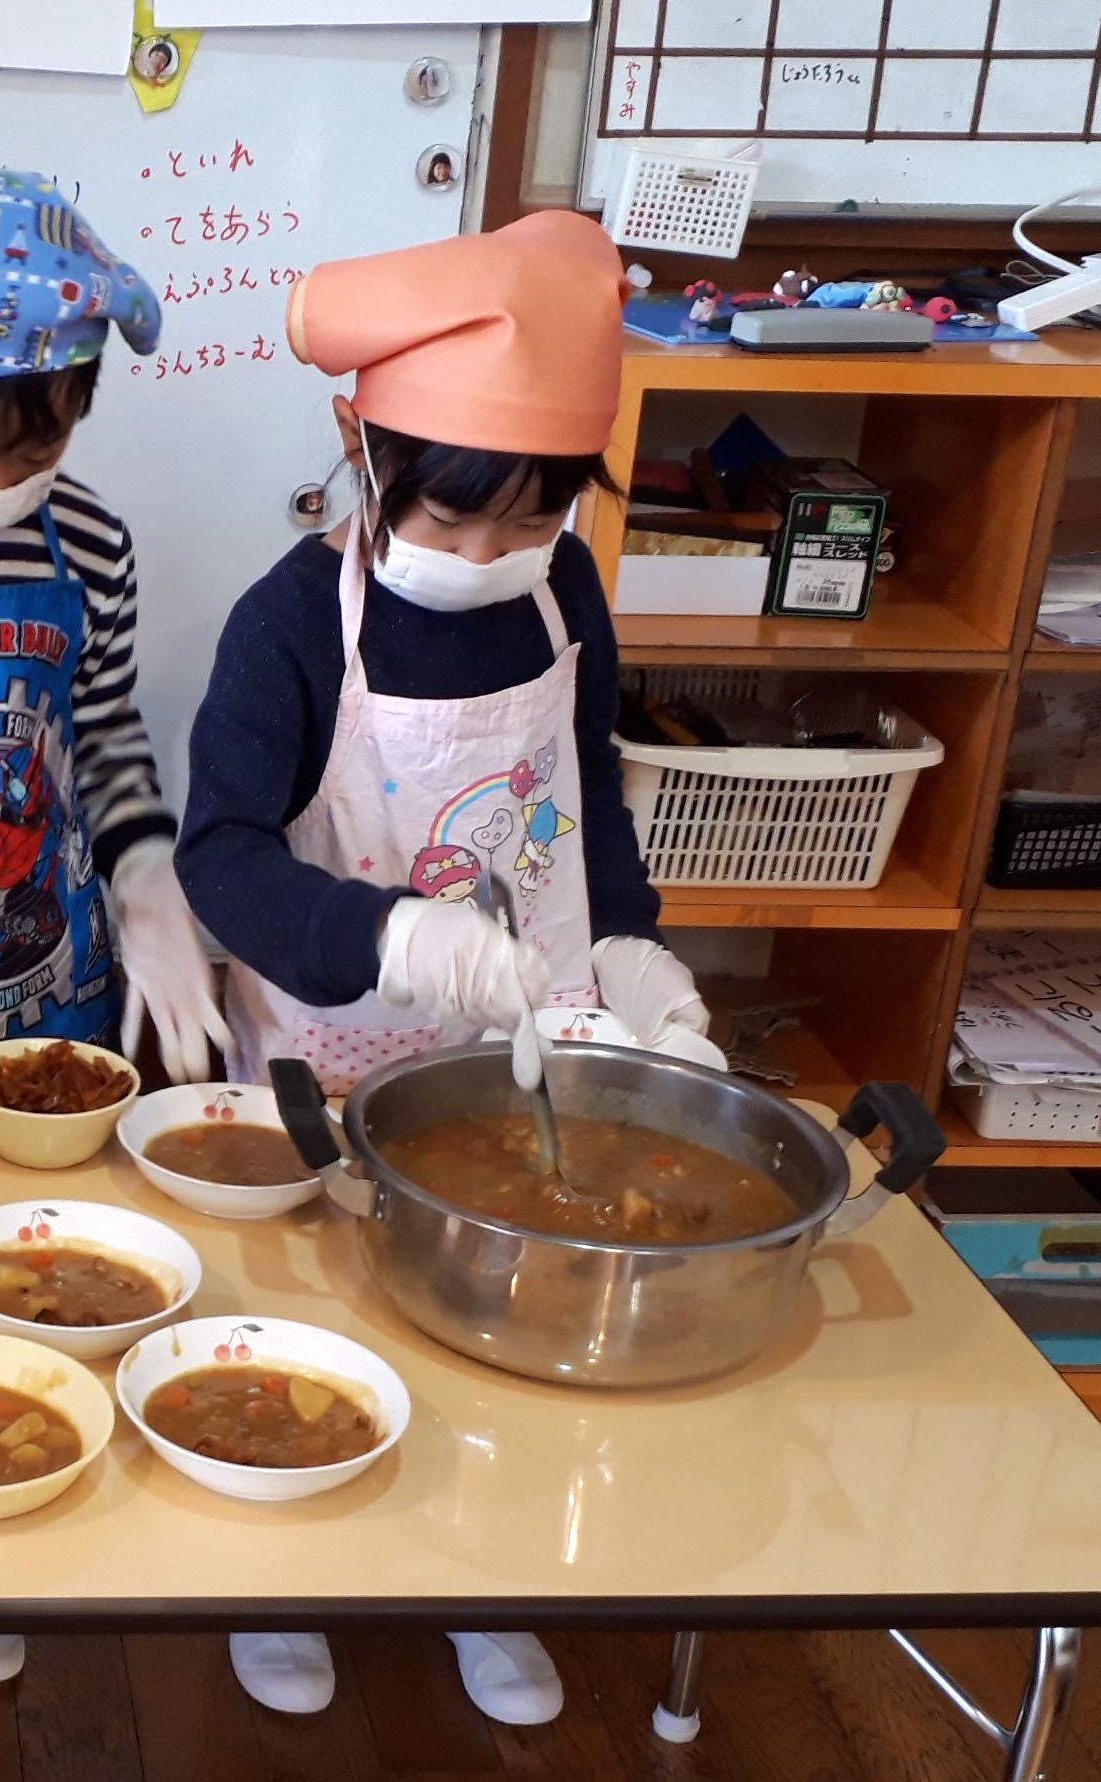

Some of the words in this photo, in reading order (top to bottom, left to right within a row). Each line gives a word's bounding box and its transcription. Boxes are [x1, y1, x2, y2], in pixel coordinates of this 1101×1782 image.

[619, 60, 641, 120] やすみ
[168, 139, 255, 178] といれ
[165, 201, 299, 245] てをあらう
[155, 334, 276, 380] らんちるーむ
[21, 965, 54, 998] FORM
